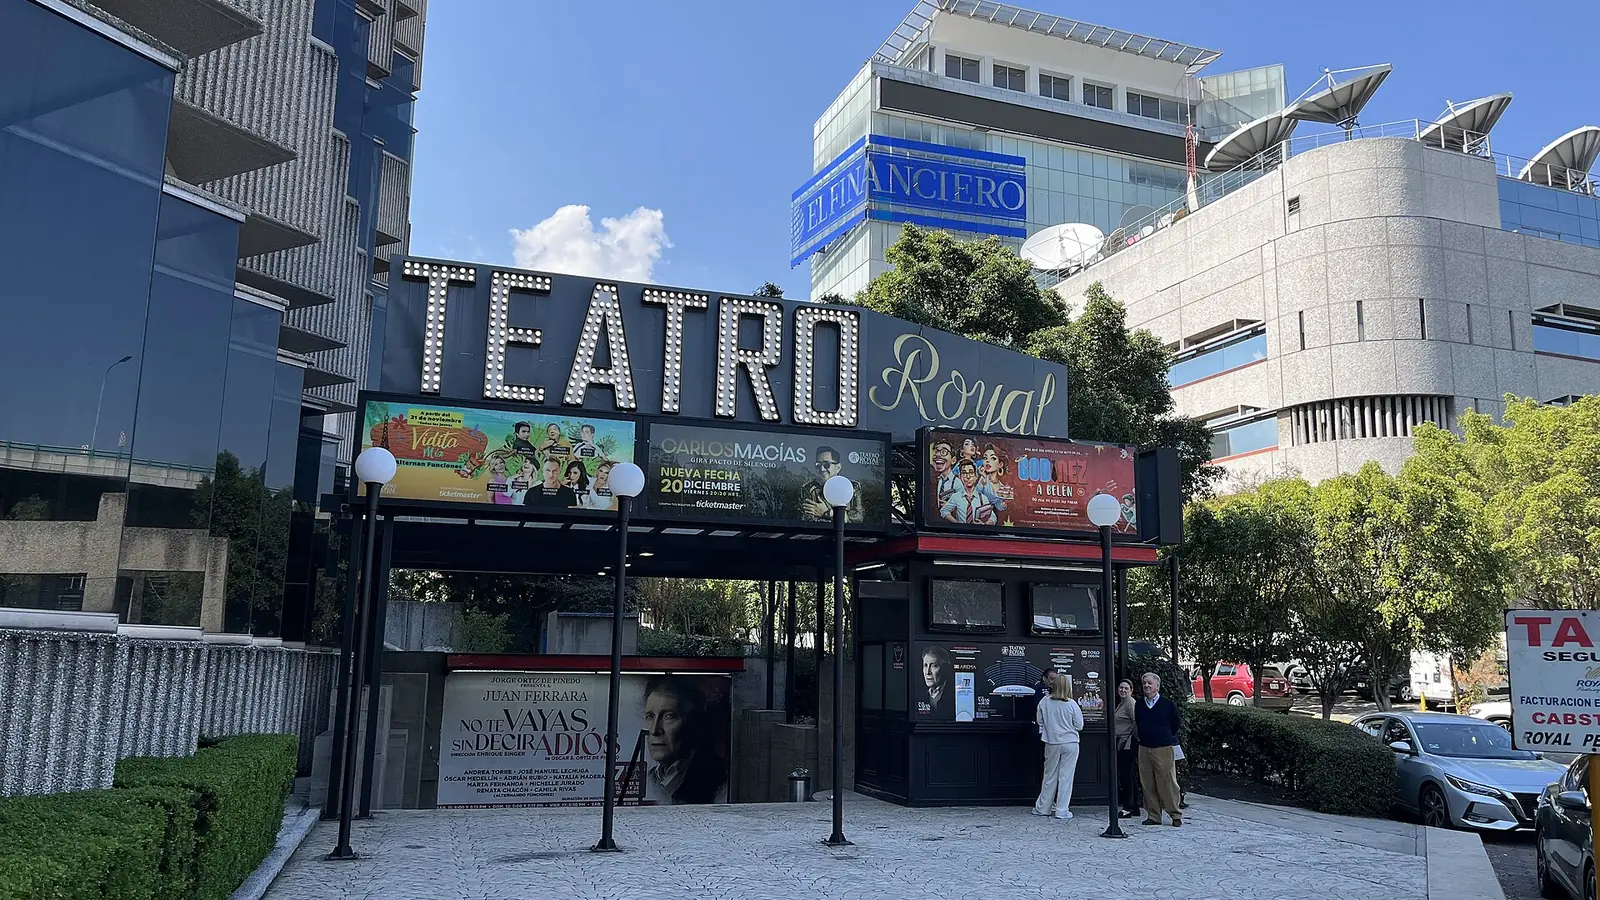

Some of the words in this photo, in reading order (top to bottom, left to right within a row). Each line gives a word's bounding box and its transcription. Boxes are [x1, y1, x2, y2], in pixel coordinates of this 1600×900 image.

[806, 197, 830, 233] EL
[829, 159, 1025, 216] FINANCIERO
[402, 260, 861, 428] TEATRO
[868, 333, 1056, 436] Royal
[412, 426, 459, 450] Vidita
[661, 438, 734, 458] CARLOS
[734, 442, 807, 463] MACÍAS
[709, 458, 732, 466] PACTO
[743, 460, 777, 469] SILENCIO
[660, 467, 702, 478] NUEVA
[704, 469, 741, 481] FECHA
[660, 478, 683, 493] 20
[683, 480, 741, 491] DICIEMBRE
[1036, 484, 1042, 495] A
[1046, 483, 1073, 497] BELÉN
[439, 490, 481, 499] ticketmaster
[695, 499, 744, 510] ticketmaster
[483, 690, 521, 702] JUAN
[524, 690, 589, 702] FERRARA
[1520, 696, 1591, 708] FACTURACION
[460, 719, 483, 732] NO
[485, 719, 504, 732] TE
[502, 707, 589, 732] VAYAS
[452, 739, 475, 751] SIN
[475, 733, 535, 751] DECIR
[1523, 730, 1572, 746] ROYAL
[503, 773, 527, 781] ADRIÁN
